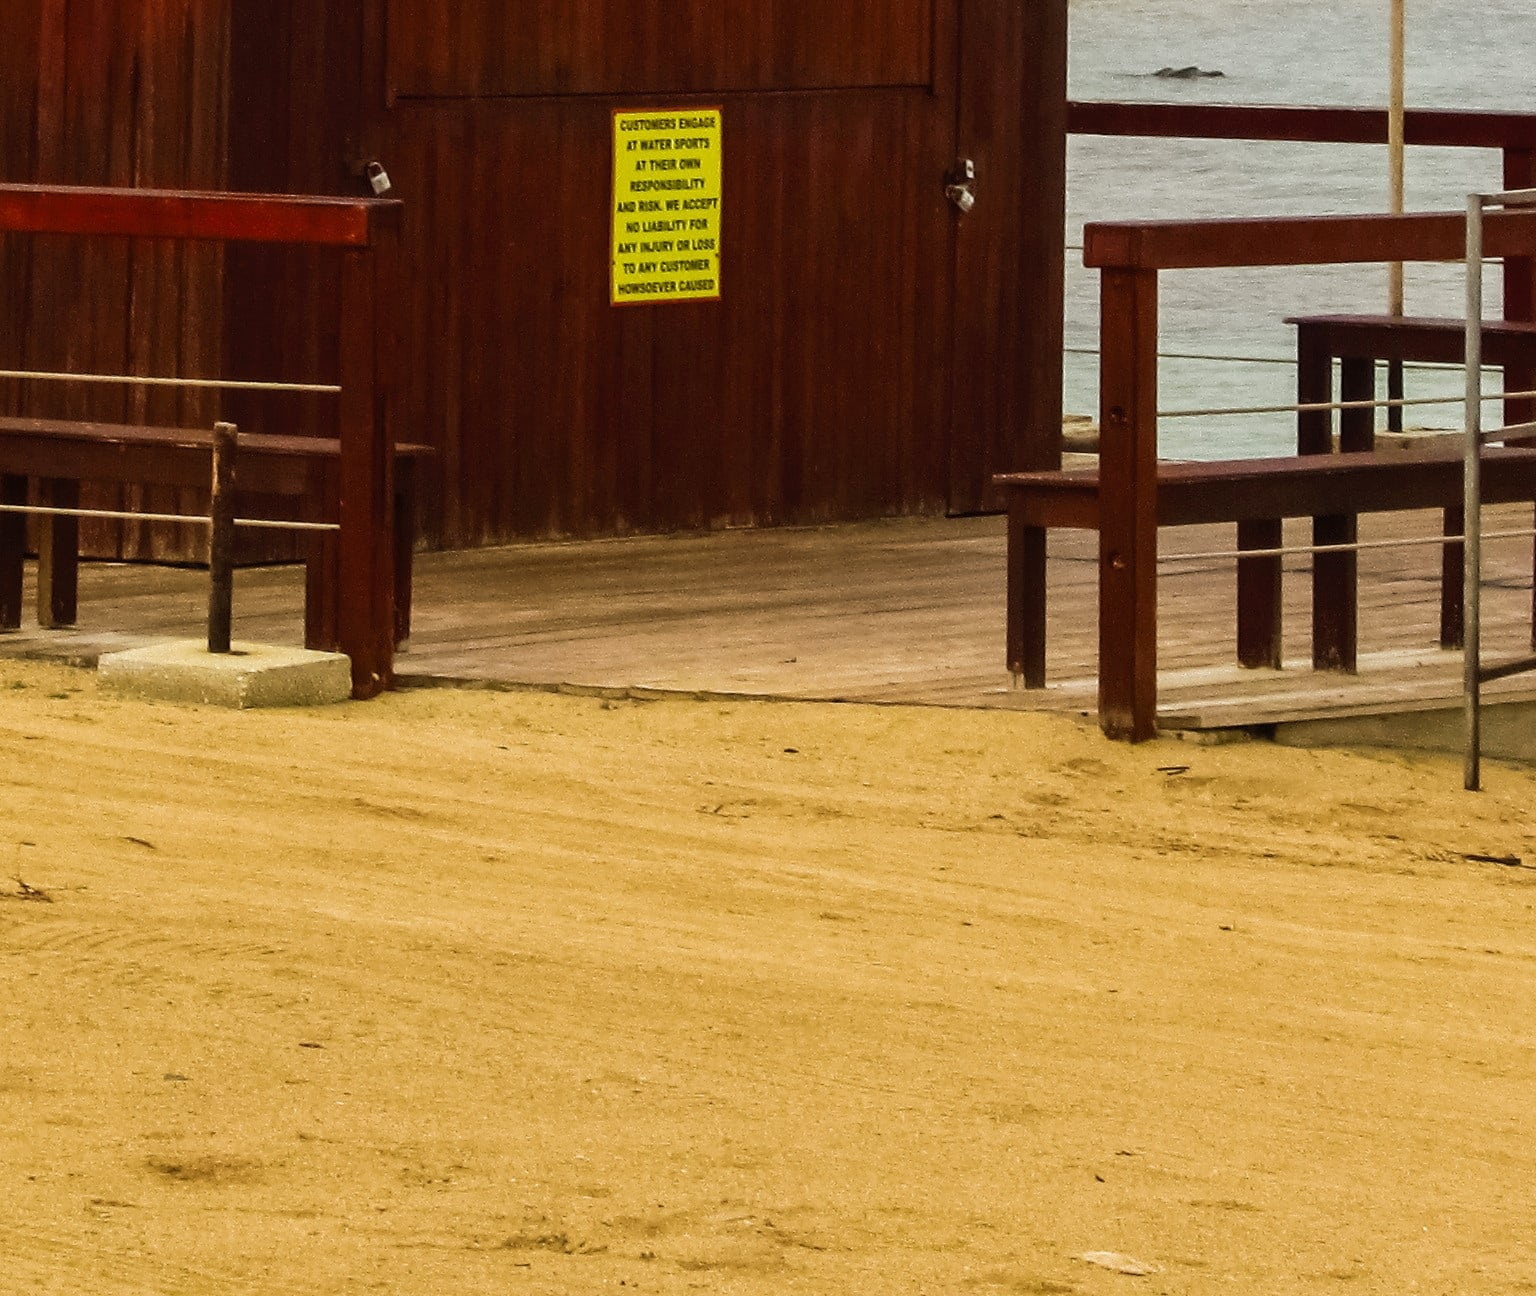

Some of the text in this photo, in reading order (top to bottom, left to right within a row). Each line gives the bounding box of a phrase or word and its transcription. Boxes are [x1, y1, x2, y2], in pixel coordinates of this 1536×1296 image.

[620, 117, 715, 131] CUSTOMERS ENGAGE
[627, 138, 710, 151] AT WATER SPORTS
[635, 159, 701, 171] AT THEIR OWN
[629, 179, 704, 192] RESPONSIBILITY
[617, 201, 636, 212] AND
[665, 199, 680, 210] WE
[683, 198, 718, 209] ACCEPT
[626, 219, 708, 233] NO LIABILITY FOR
[618, 239, 715, 253] ANY INJURY OR LOSS
[623, 259, 710, 274] TO ANY CUSTOMER
[618, 279, 715, 294] HOWSOEVER CAUSED
